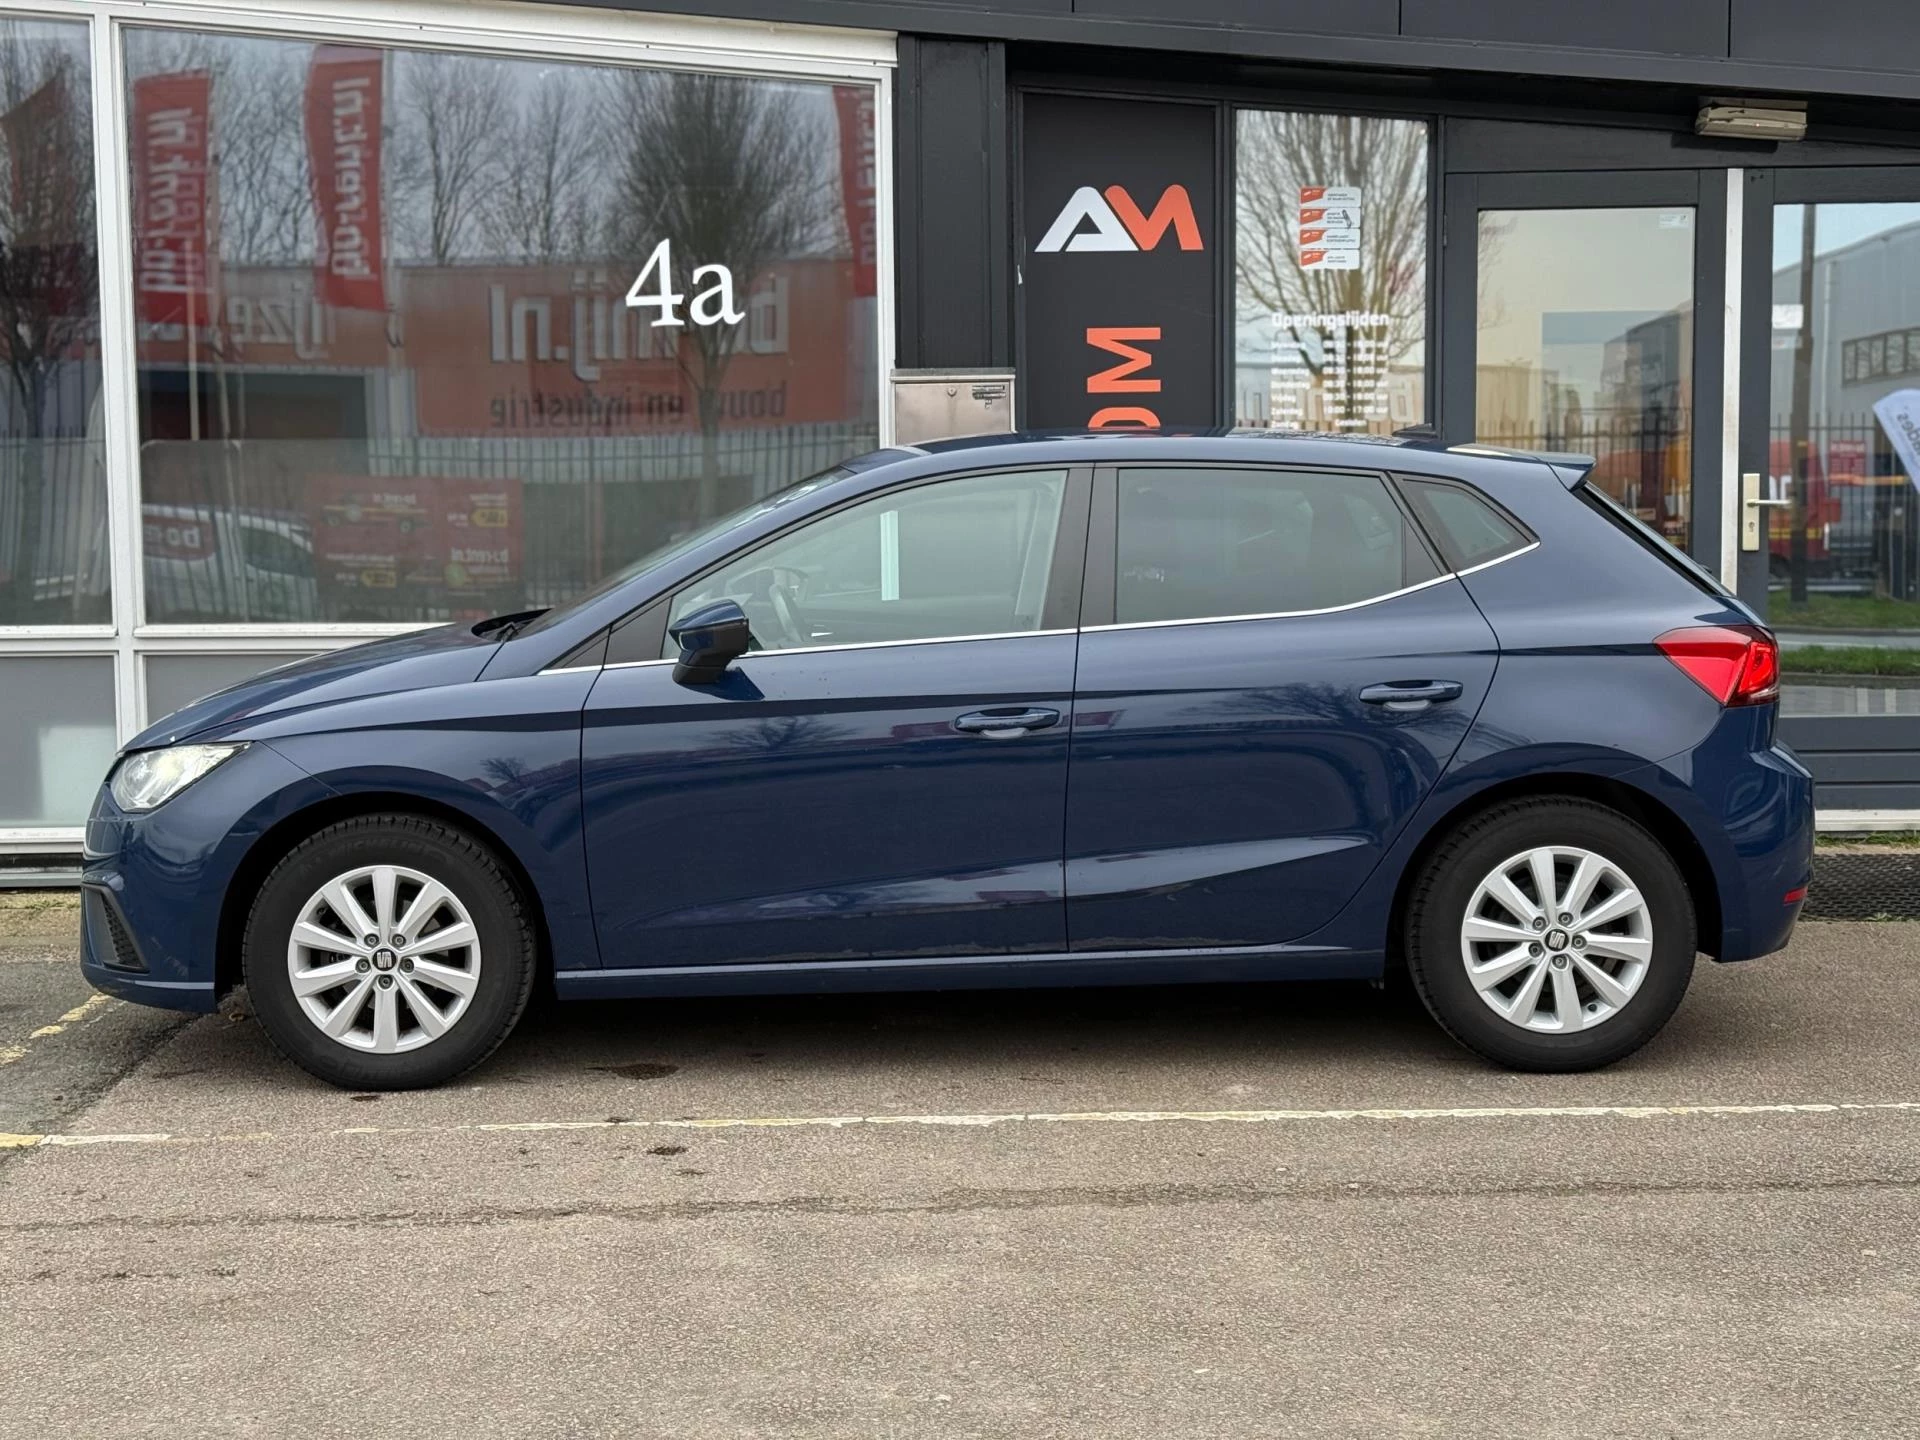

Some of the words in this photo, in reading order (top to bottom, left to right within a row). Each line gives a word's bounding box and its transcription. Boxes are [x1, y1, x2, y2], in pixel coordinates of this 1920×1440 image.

[1034, 184, 1204, 252] AM
[625, 238, 746, 327] 4a
[1271, 311, 1390, 331] Openingstijden
